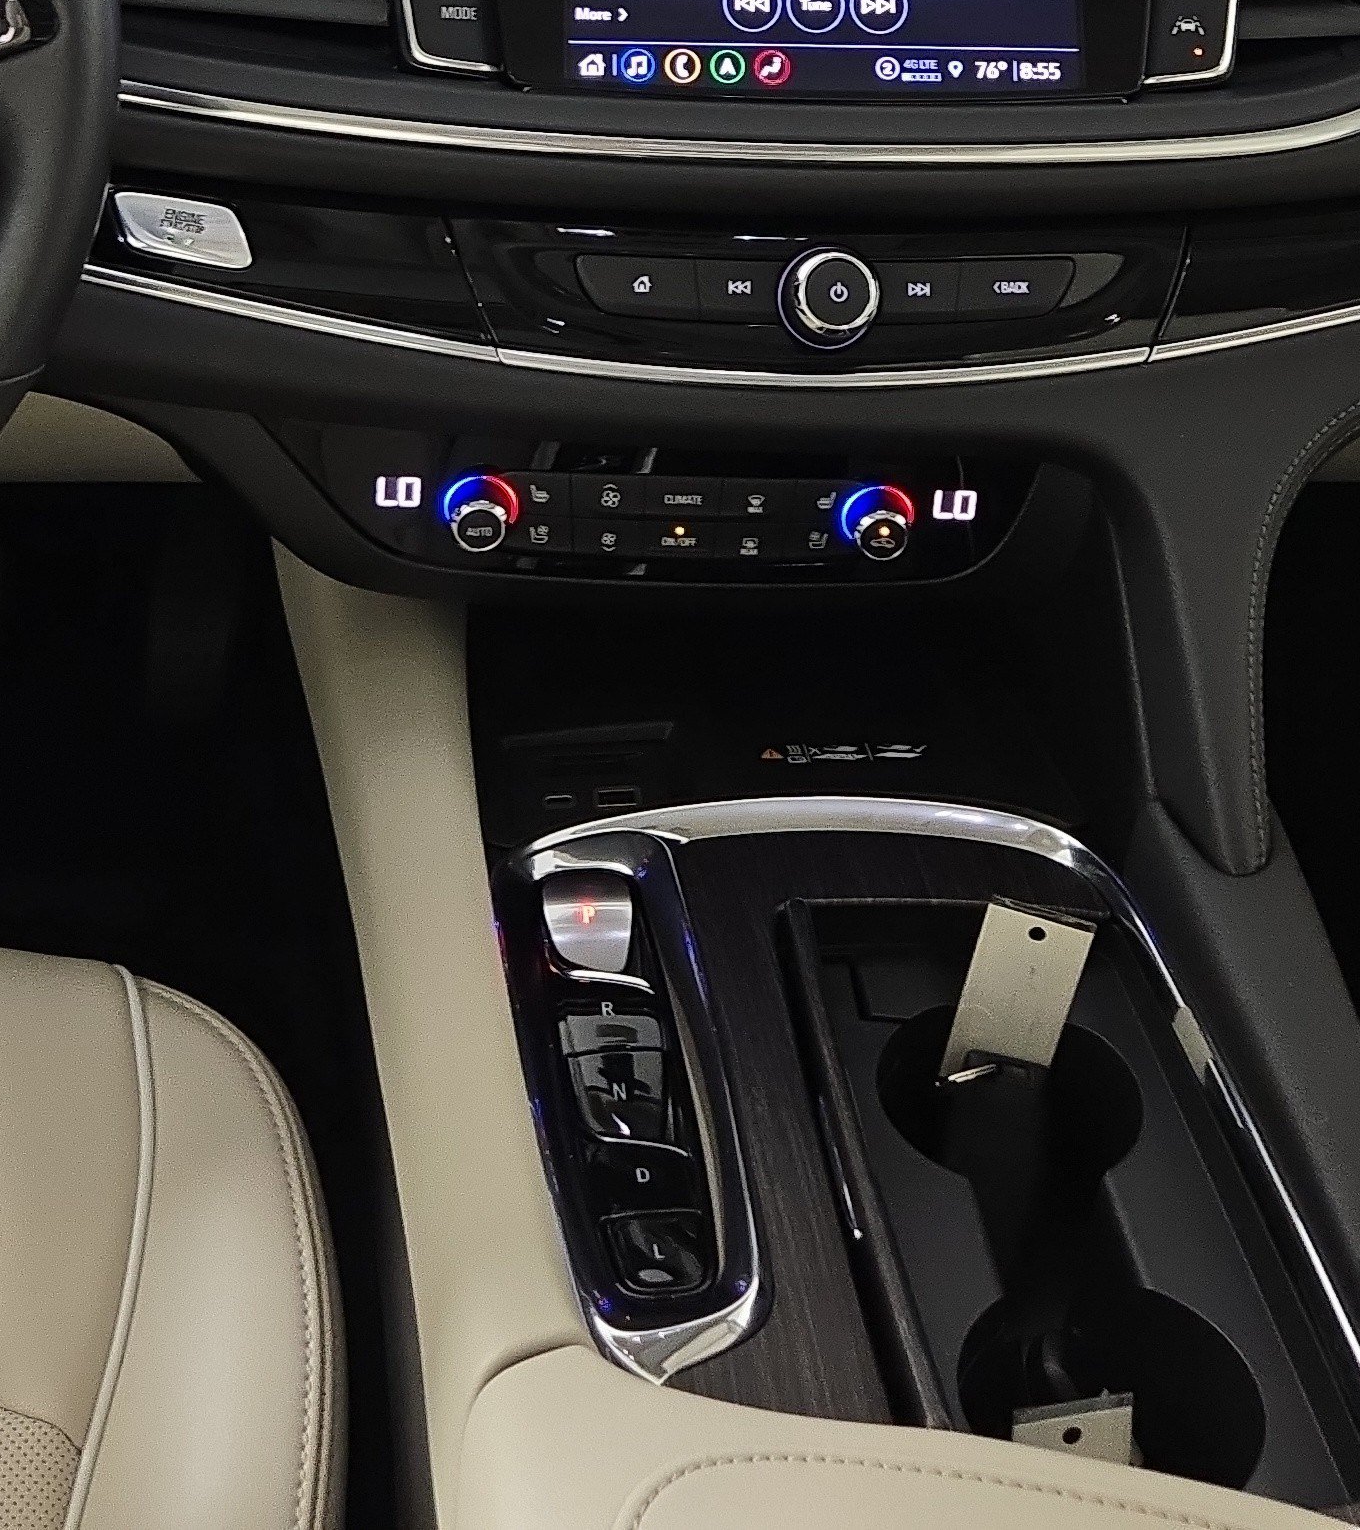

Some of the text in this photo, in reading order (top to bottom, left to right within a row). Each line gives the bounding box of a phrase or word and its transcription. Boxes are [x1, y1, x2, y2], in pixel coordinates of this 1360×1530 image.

[441, 6, 478, 20] MODE
[575, 7, 612, 21] More
[975, 60, 1008, 79] 76°
[1019, 62, 1062, 80] 8:55
[1000, 281, 1030, 294] BACK
[375, 476, 422, 508] LO
[932, 489, 978, 520] LO
[581, 904, 596, 923] P
[601, 1002, 615, 1016] R
[612, 1082, 627, 1101] N
[636, 1168, 650, 1183] D
[653, 1244, 665, 1259] L
